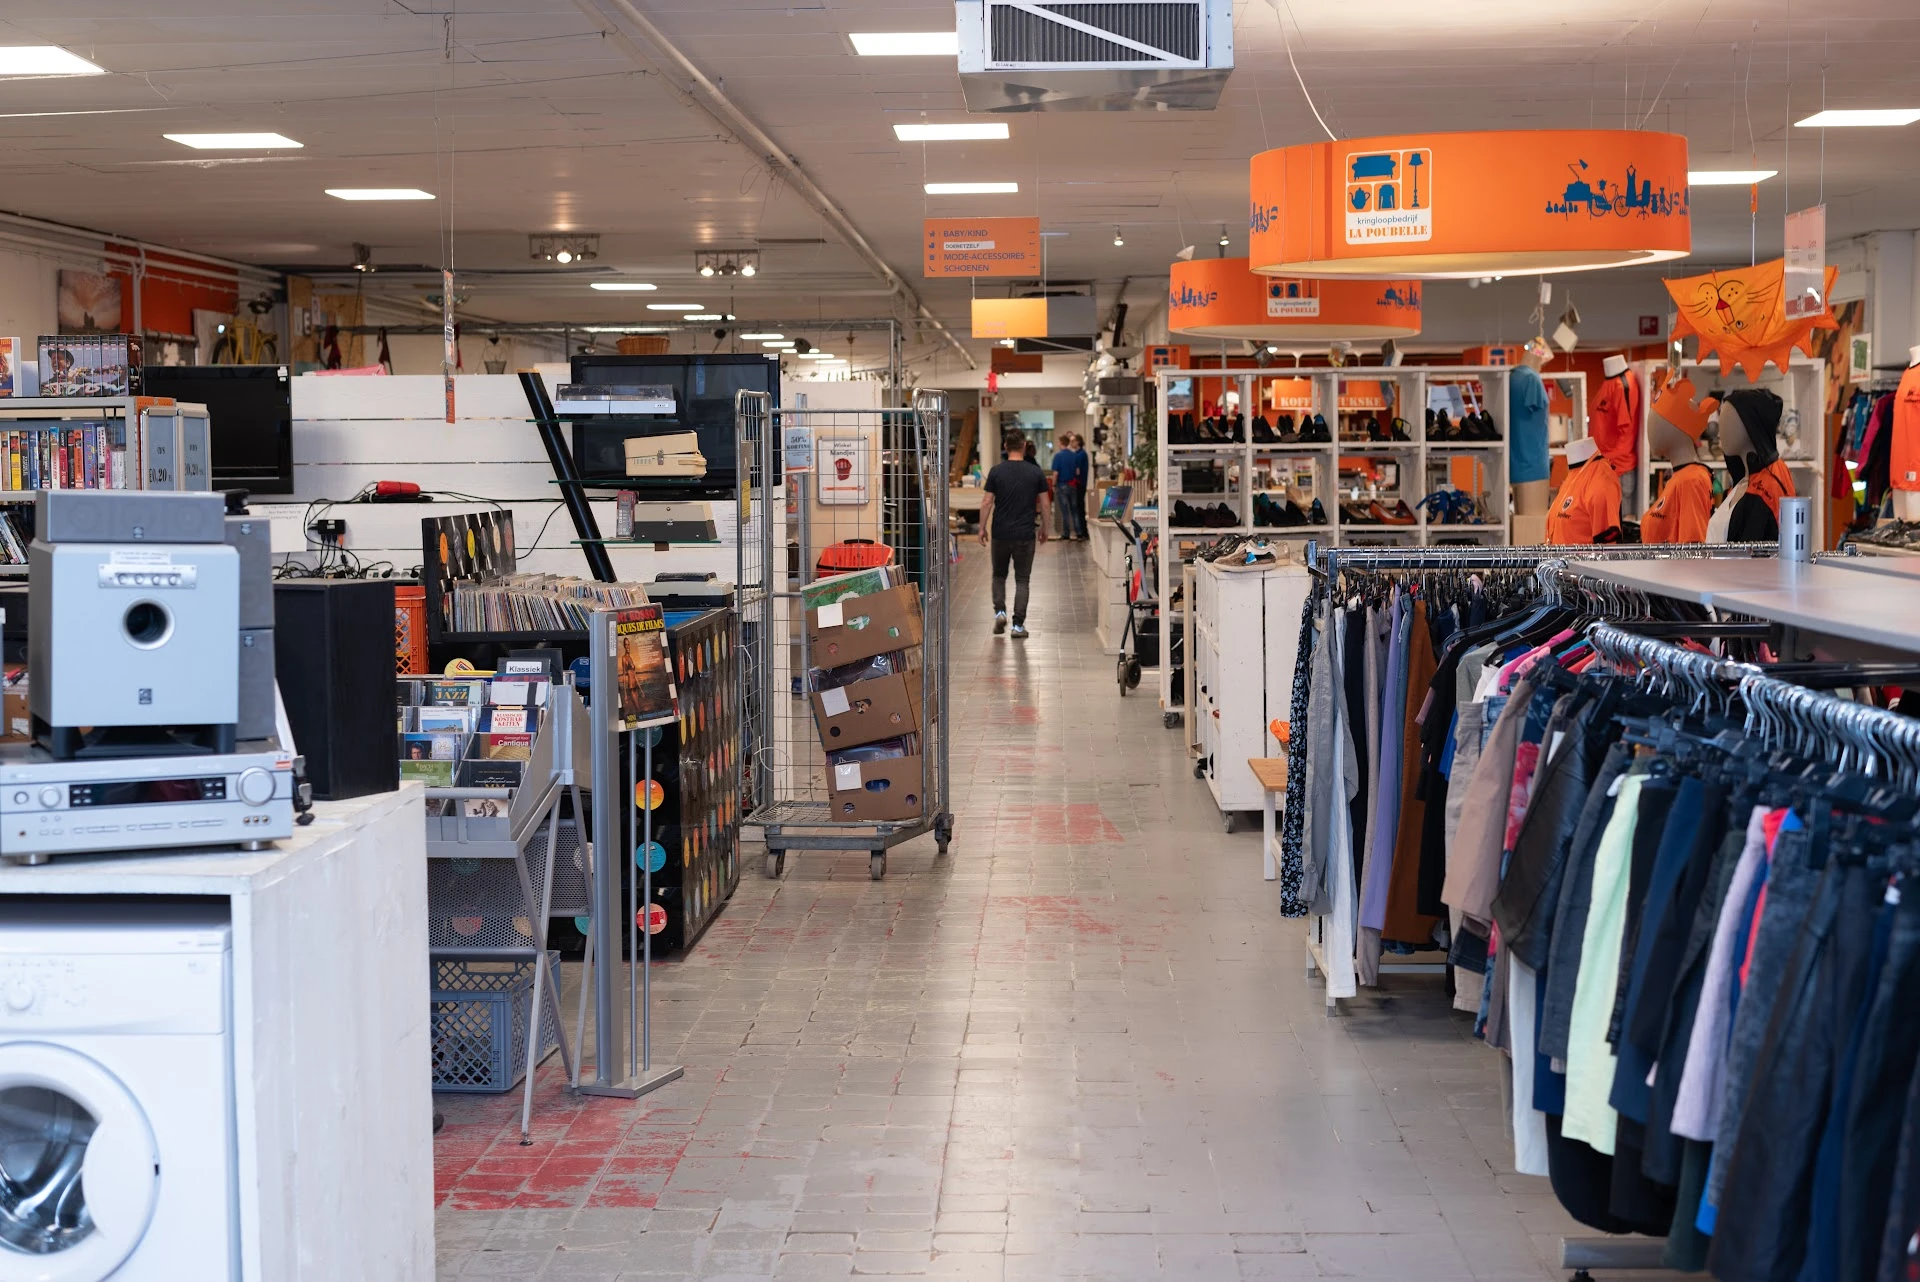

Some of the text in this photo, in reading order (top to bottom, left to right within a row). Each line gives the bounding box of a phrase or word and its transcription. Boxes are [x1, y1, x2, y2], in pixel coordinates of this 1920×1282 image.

[1357, 214, 1418, 226] kringloopbedrijf
[943, 230, 988, 238] BABY/KIND
[1349, 225, 1428, 239] LA POUBELLE
[943, 252, 1025, 261] MODE-ACCESSOIRES
[943, 264, 989, 272] SCHOENEN
[629, 608, 656, 621] ROSSO
[645, 618, 665, 631] FILMS
[509, 665, 541, 673] Klassiek
[435, 691, 468, 700] JAZZ
[497, 739, 529, 747] Cantiqua
